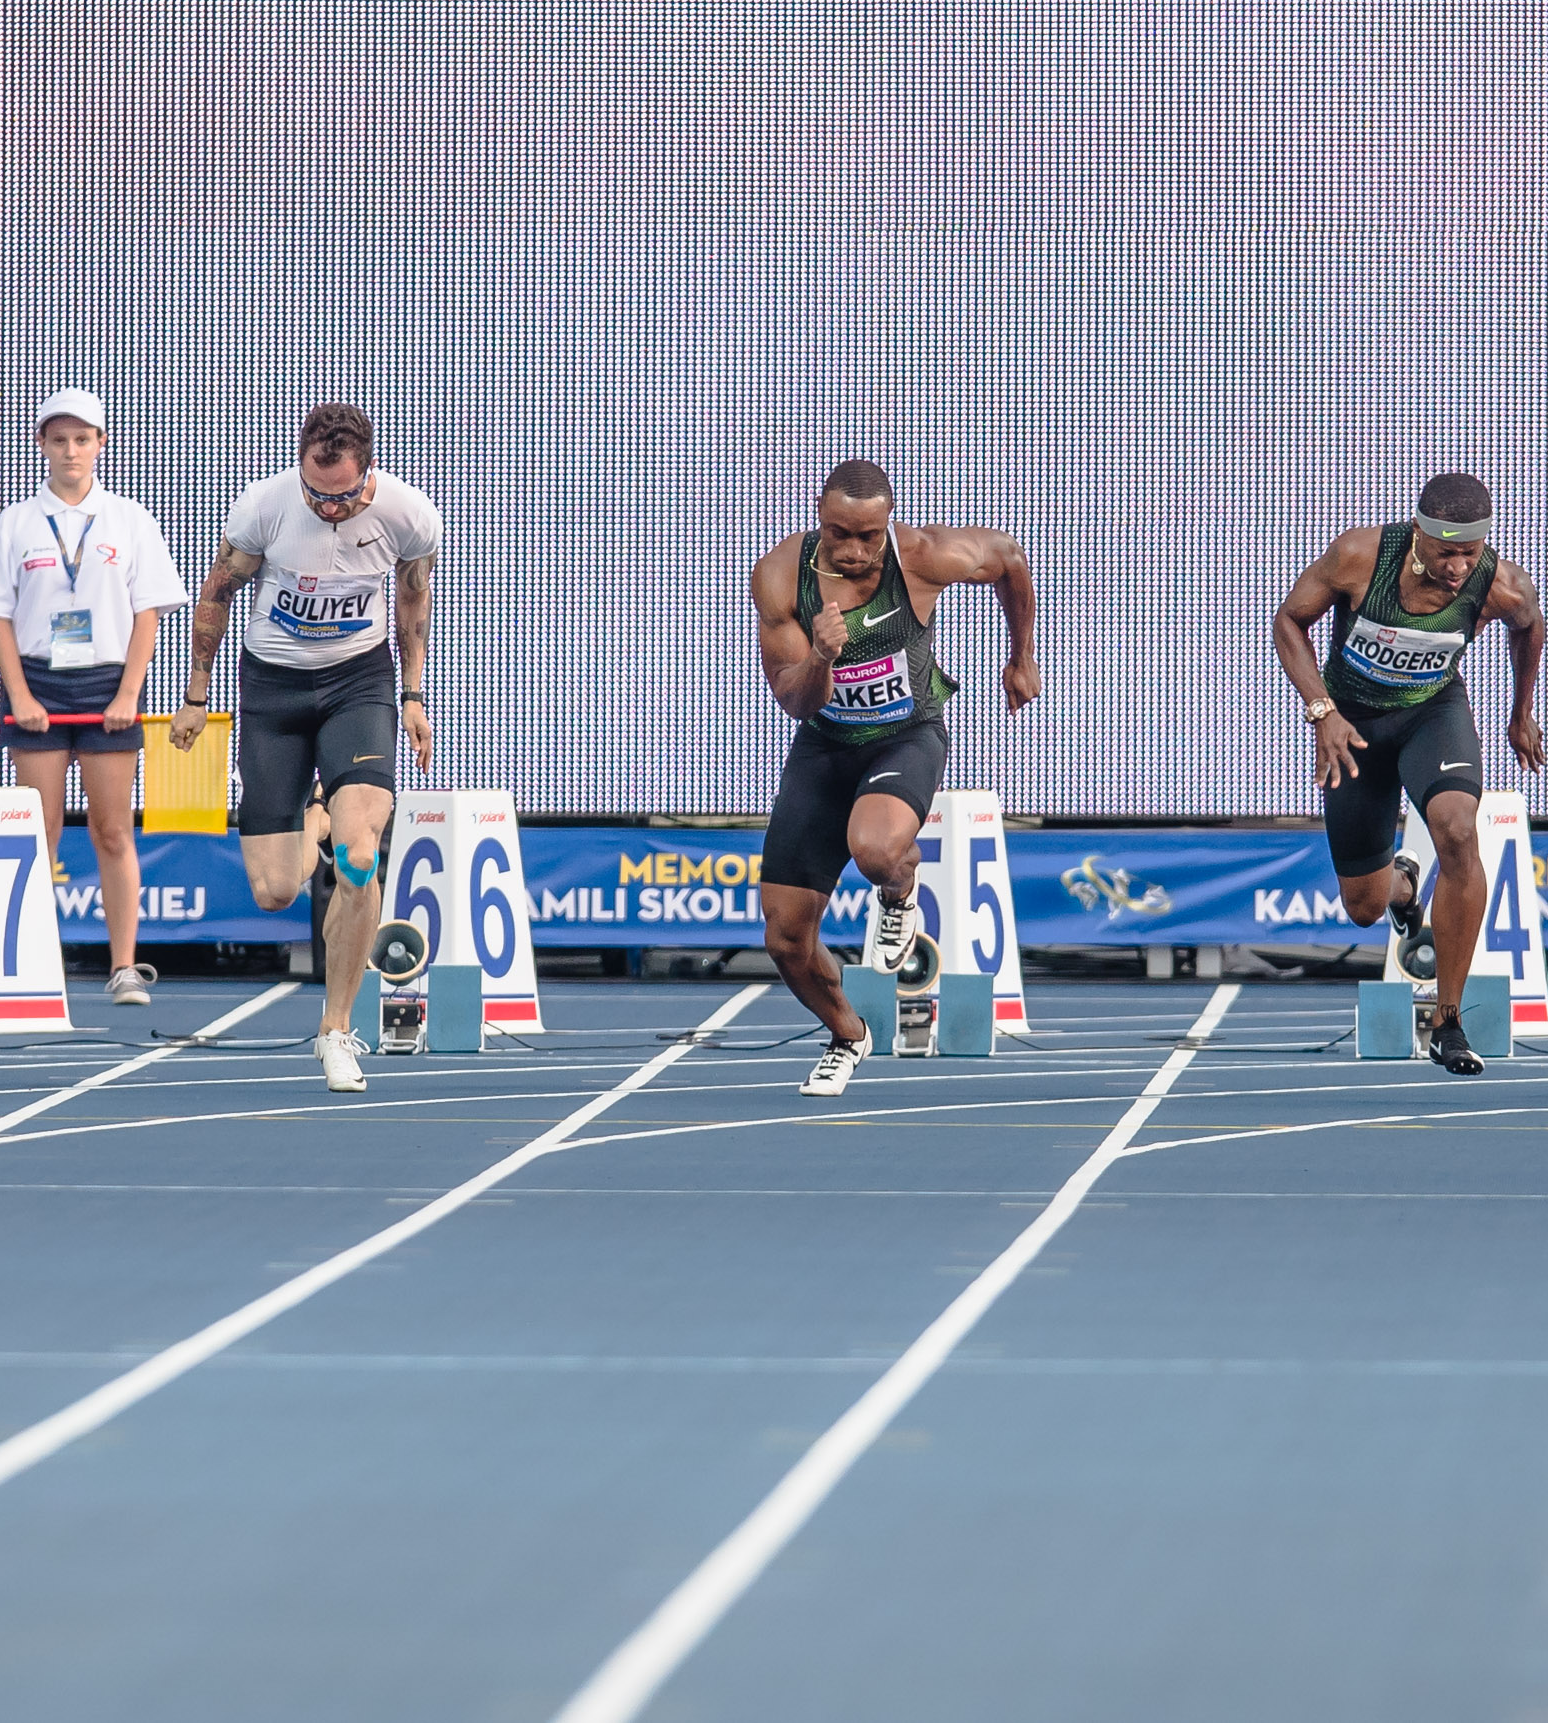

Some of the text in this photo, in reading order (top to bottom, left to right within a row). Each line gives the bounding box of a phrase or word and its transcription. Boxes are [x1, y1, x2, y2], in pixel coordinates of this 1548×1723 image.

[277, 589, 373, 621] GULIYEV
[1351, 634, 1450, 671] RODGERS
[837, 662, 887, 681] TAURON
[831, 675, 907, 708] AKER
[1, 808, 32, 823] polanik
[416, 811, 446, 825] polanik
[394, 836, 444, 977] 6
[470, 837, 516, 979] 6
[525, 888, 627, 923] AMILI
[970, 837, 1005, 978] 5
[1485, 838, 1531, 980] 4
